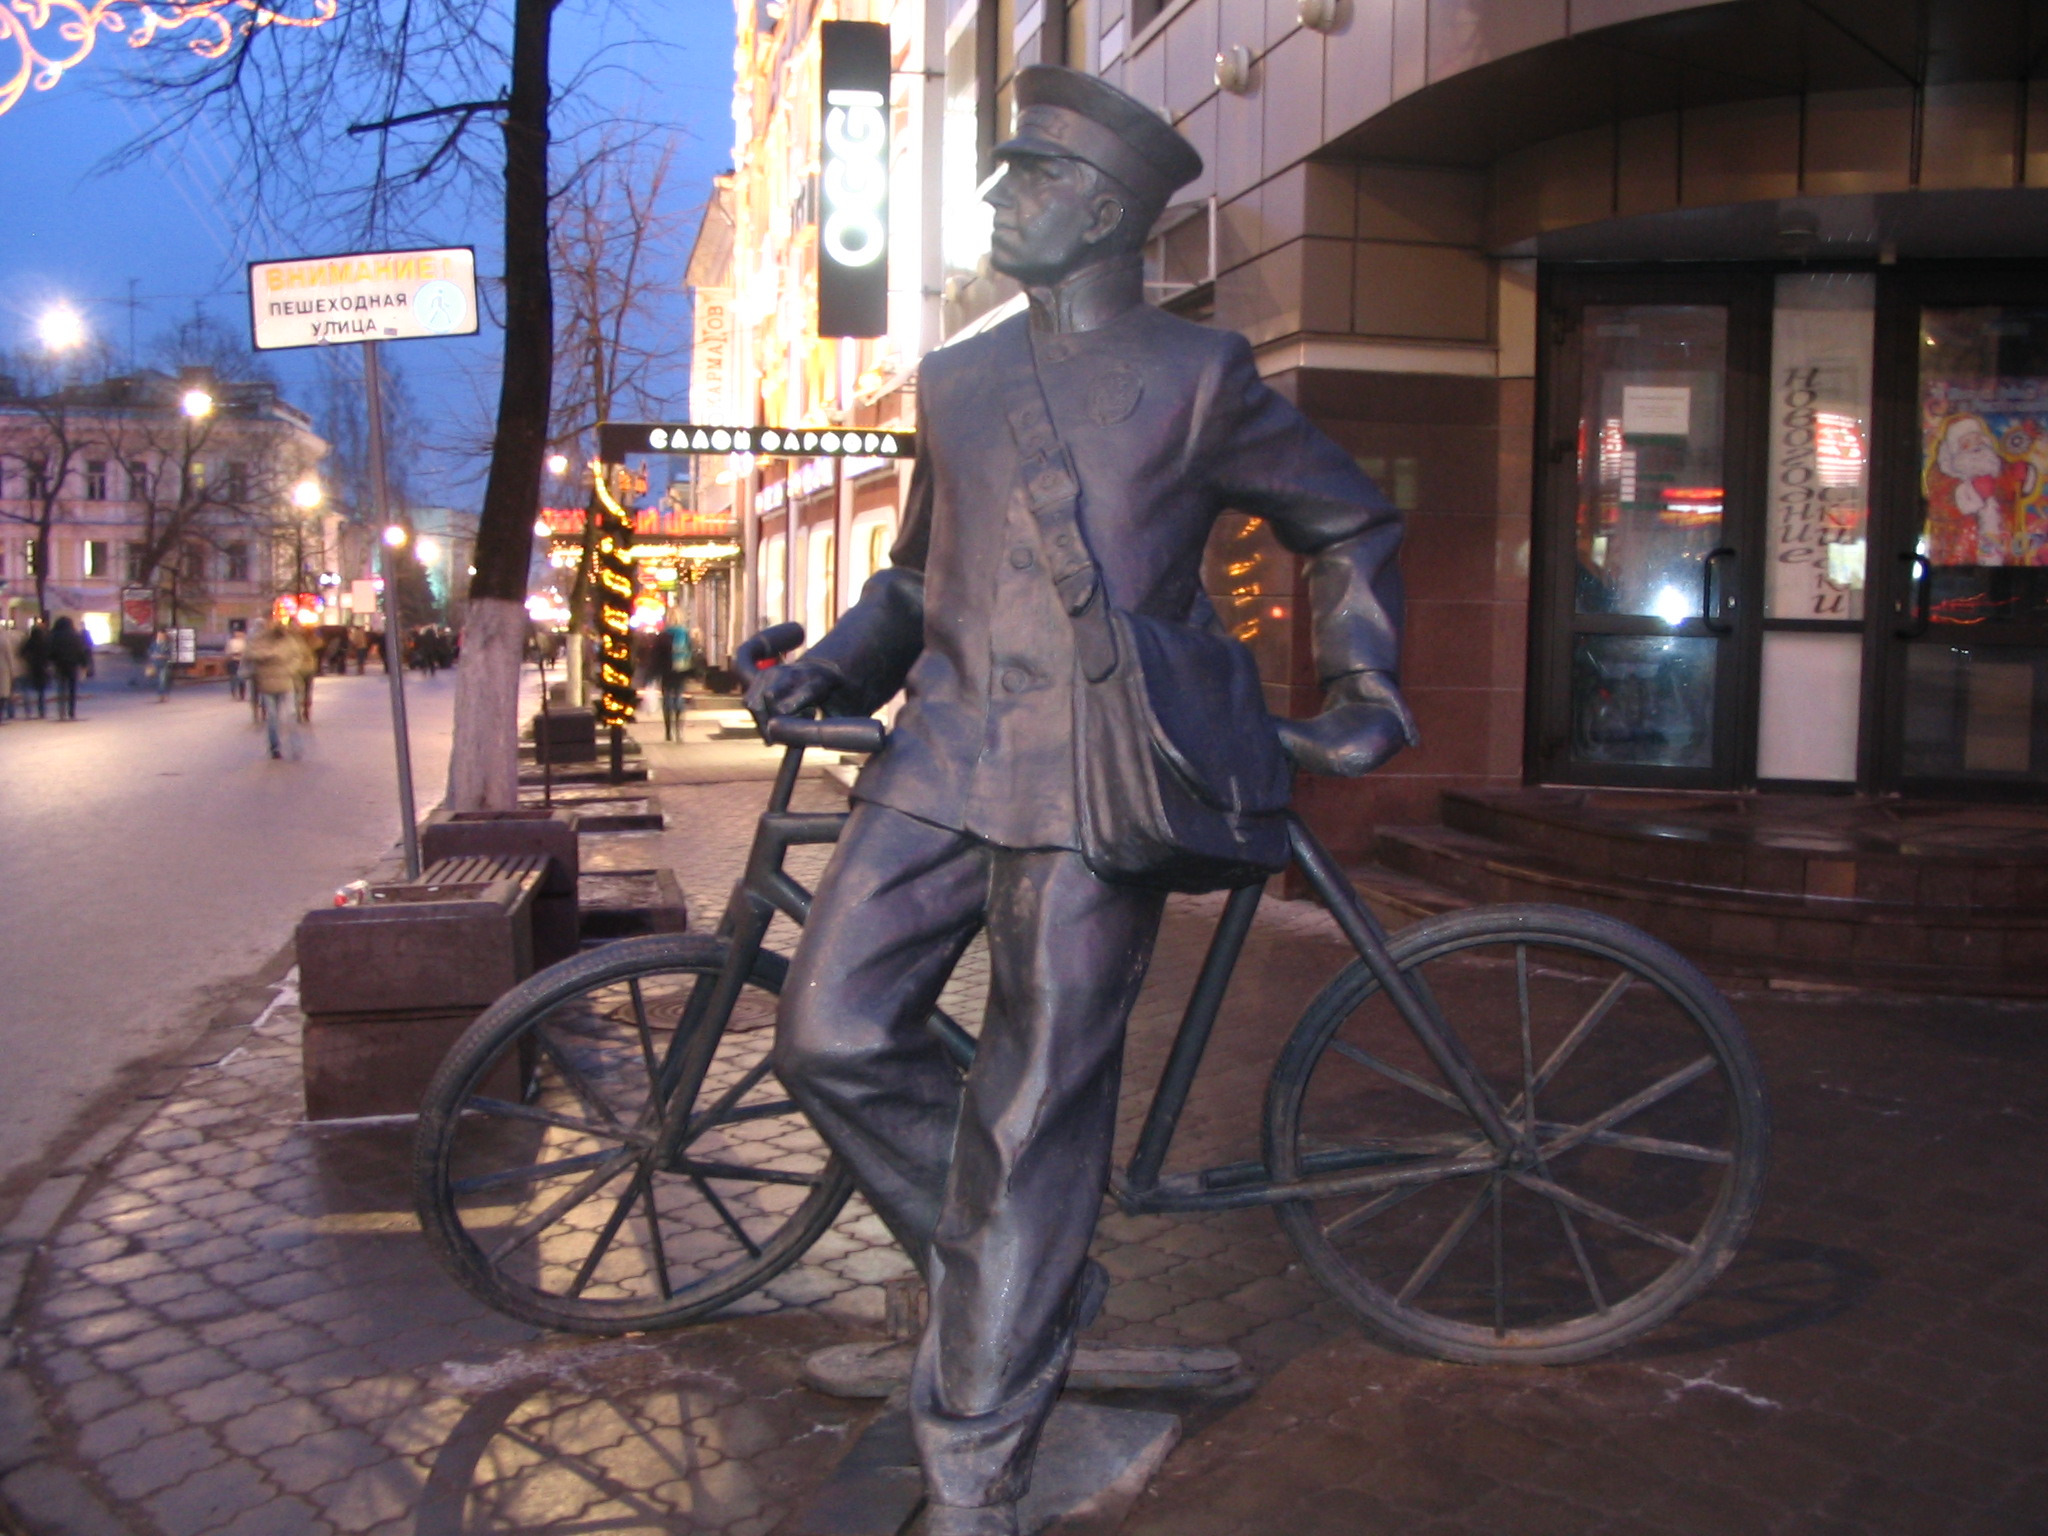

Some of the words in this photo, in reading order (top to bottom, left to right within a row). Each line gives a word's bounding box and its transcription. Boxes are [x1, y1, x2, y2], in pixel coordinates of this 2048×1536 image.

[825, 89, 886, 267] OGGI
[269, 293, 407, 317] ПЕШЕХОДНАЯ
[311, 318, 377, 337] УЛИЦА
[760, 430, 898, 454] ФАРФОРА
